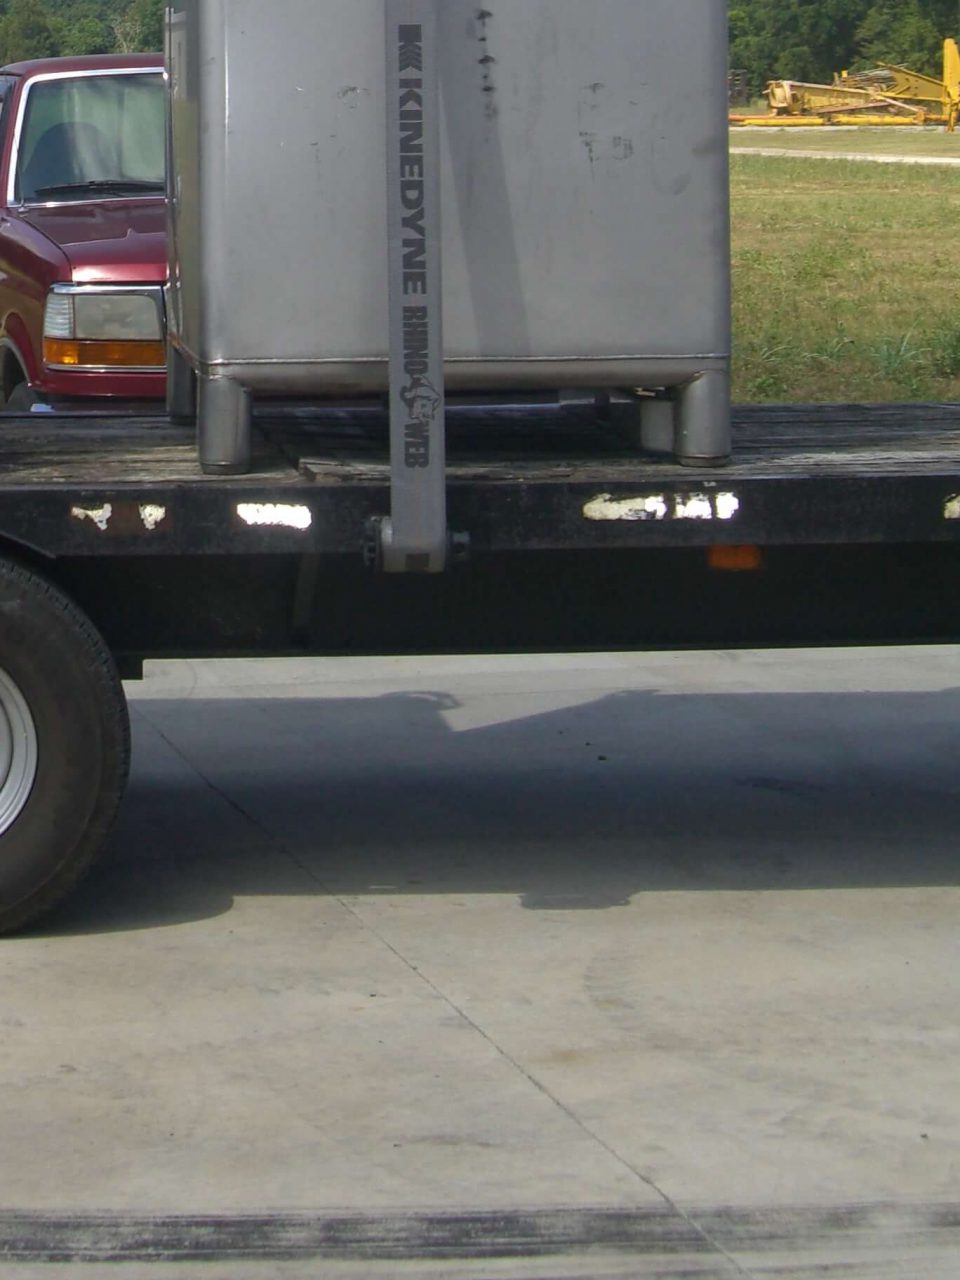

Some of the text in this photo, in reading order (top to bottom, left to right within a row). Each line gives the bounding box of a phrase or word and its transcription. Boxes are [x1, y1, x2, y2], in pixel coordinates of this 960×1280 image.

[398, 78, 428, 296] KINEDYNE
[403, 305, 429, 377] RHINO
[404, 420, 429, 469] WEB
